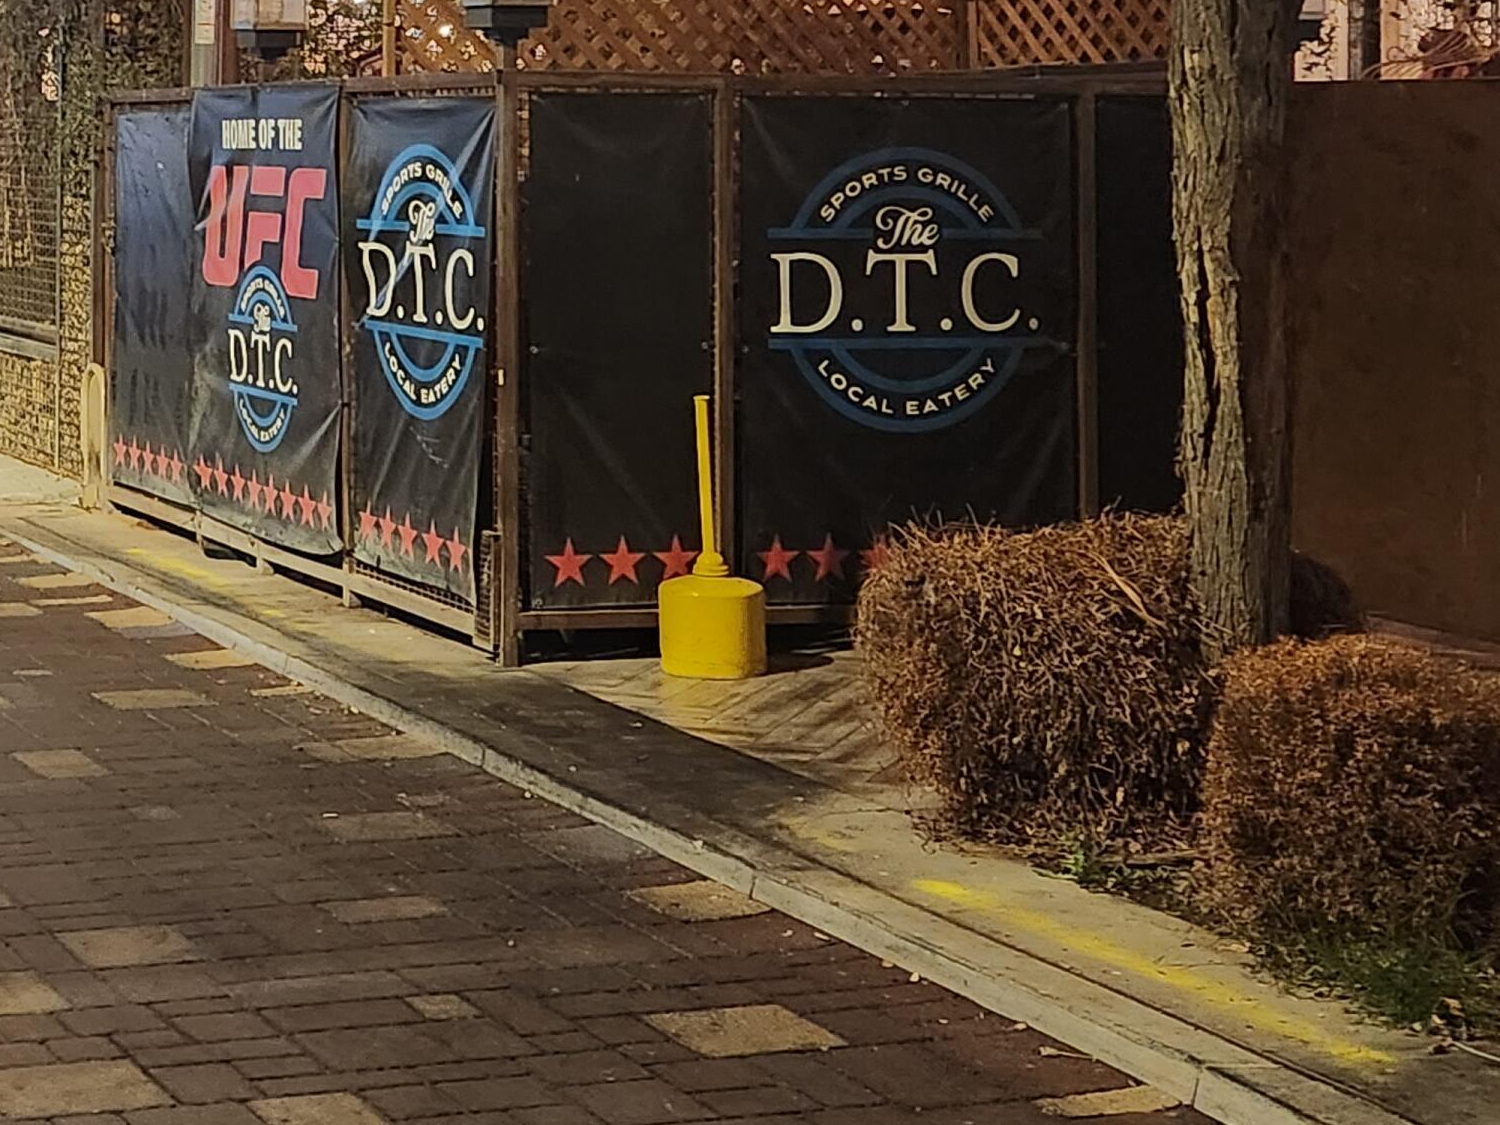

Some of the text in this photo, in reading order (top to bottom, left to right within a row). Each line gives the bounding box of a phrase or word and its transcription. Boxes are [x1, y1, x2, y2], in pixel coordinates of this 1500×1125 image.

[221, 119, 303, 150] HOME OF THE
[381, 161, 464, 220] SPORTS GRILLE
[820, 165, 994, 223] SPORTS GRILLE
[203, 165, 327, 300] UFC
[408, 200, 436, 243] The
[875, 205, 940, 250] The
[357, 241, 485, 331] D.T.C.
[769, 249, 1040, 334] D.T.C.
[227, 328, 298, 395] D.T.C.
[384, 341, 463, 404] LOCAL EATERY
[816, 357, 997, 416] LOCAL EATERY
